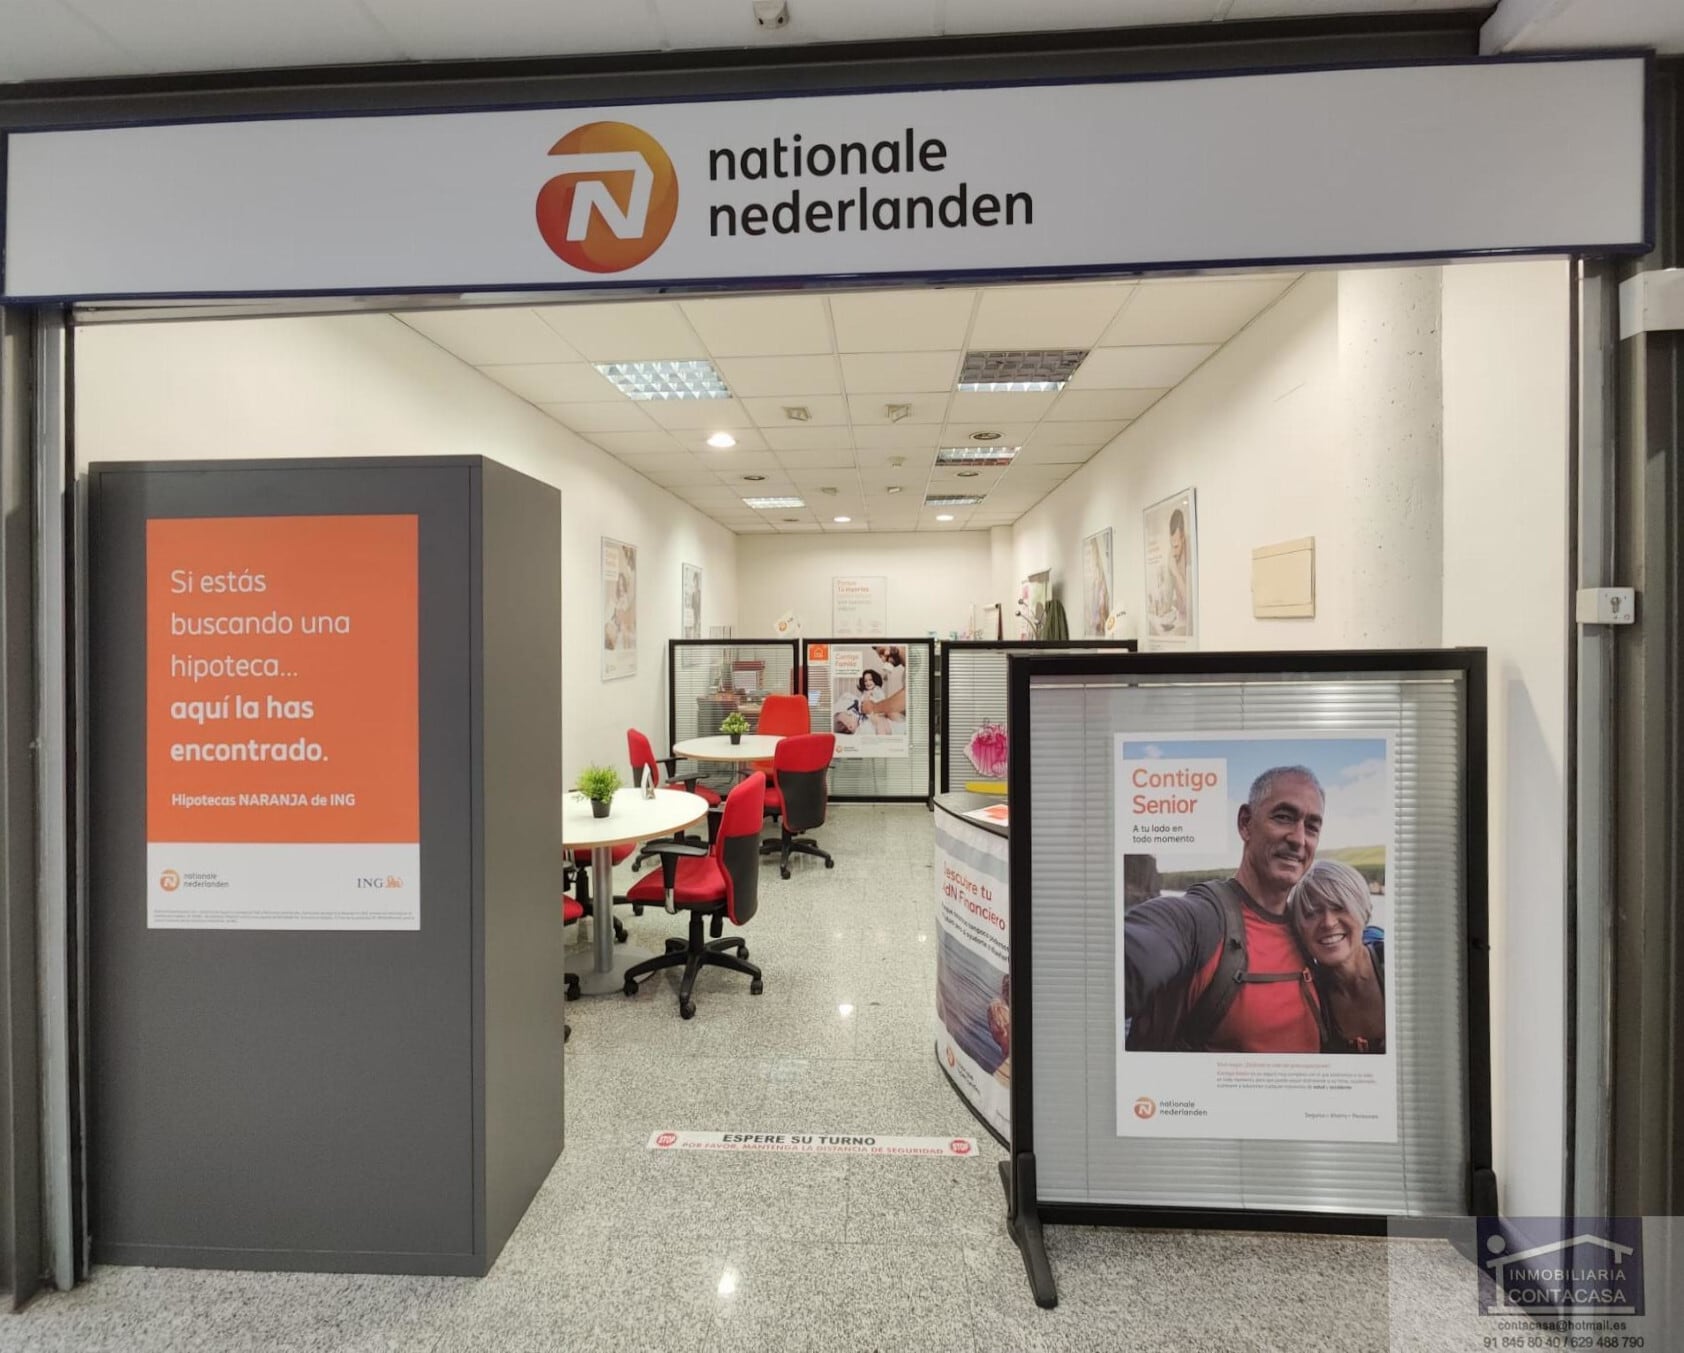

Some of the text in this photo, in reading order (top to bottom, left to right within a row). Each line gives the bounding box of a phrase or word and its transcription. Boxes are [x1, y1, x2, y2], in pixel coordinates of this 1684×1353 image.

[710, 127, 947, 181] nationale
[710, 183, 1033, 237] nederlanden
[171, 570, 266, 593] Si estás
[171, 613, 350, 635] buscando una
[171, 655, 298, 682] hipoteca...
[170, 696, 314, 724] aquí la has
[170, 739, 329, 762] encontrado.
[1132, 768, 1218, 791] Contigo
[171, 793, 356, 808] Hipotecas NARANJA de ING
[1132, 794, 1198, 814] Senior
[1151, 824, 1170, 832] lado
[1133, 834, 1195, 843] todo momento
[184, 872, 217, 880] nationale
[184, 880, 229, 888] nederlanden
[357, 877, 384, 889] ING
[959, 891, 1006, 931] Fnanciero
[1160, 1100, 1196, 1108] nationale
[1160, 1108, 1208, 1116] nederlanden
[723, 1134, 876, 1145] ESPERE SU TURNO
[742, 1143, 800, 1151] MANTENGA
[816, 1145, 868, 1153] DISTANCIA
[886, 1147, 944, 1155] SEGURIDAD
